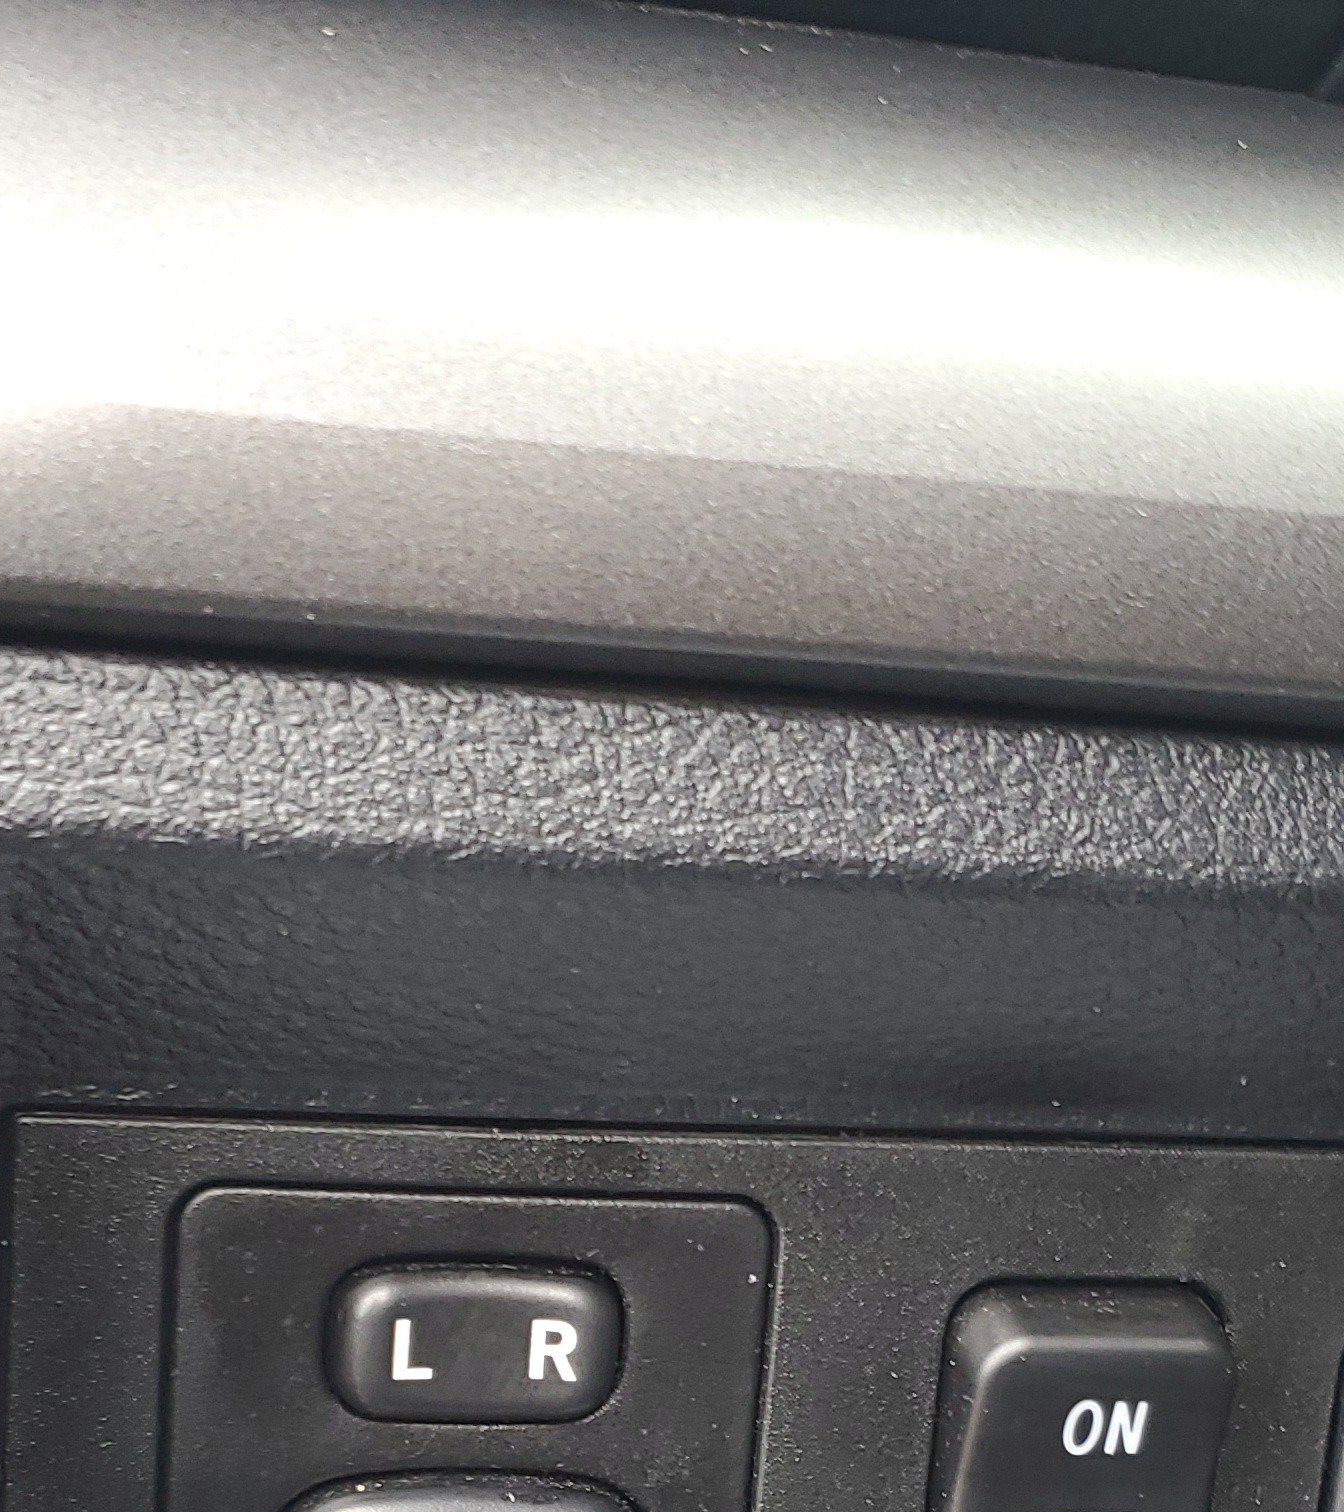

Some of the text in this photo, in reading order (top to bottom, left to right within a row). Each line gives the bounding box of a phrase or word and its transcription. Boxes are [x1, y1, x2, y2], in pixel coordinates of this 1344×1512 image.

[392, 1319, 578, 1382] L R
[1063, 1400, 1149, 1455] ON
